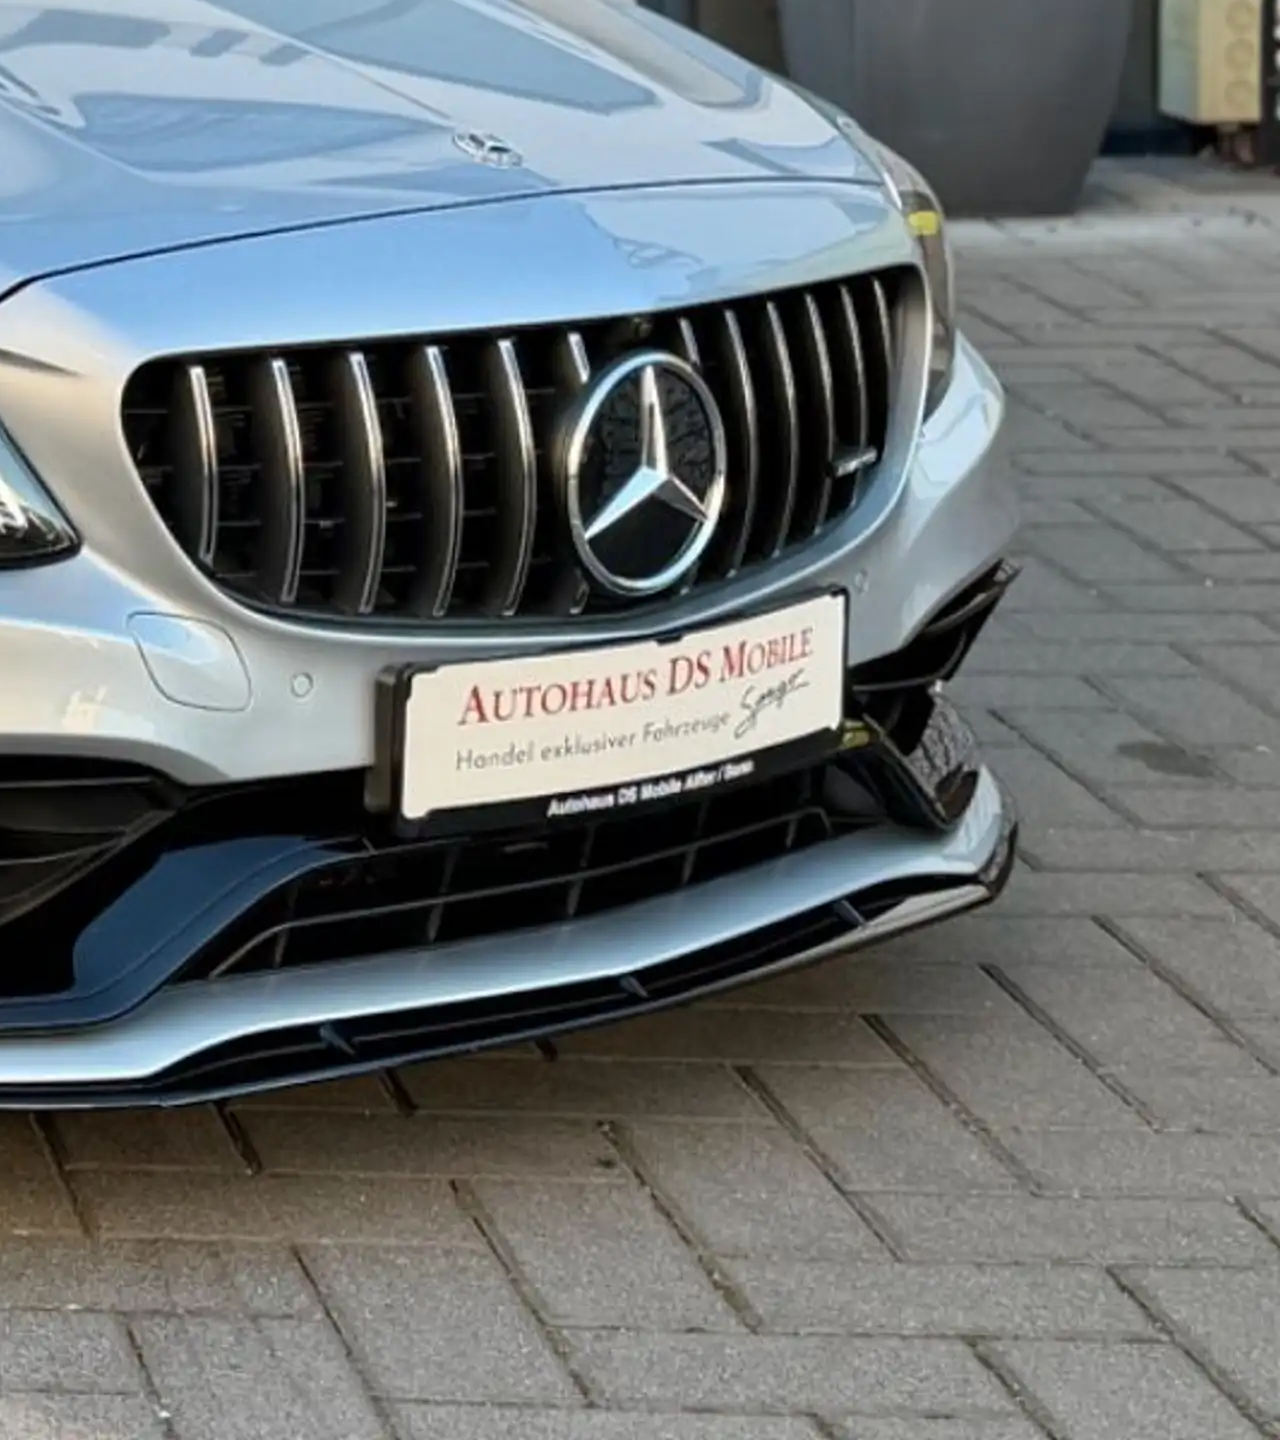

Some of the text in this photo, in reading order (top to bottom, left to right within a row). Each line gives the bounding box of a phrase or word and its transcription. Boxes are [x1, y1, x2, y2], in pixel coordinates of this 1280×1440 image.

[456, 628, 814, 727] AUTOHAUS DS MOBILE
[455, 712, 731, 771] Handel exklusiver Fahrzeuge
[546, 793, 614, 818] Autohaus
[617, 785, 639, 806] DS
